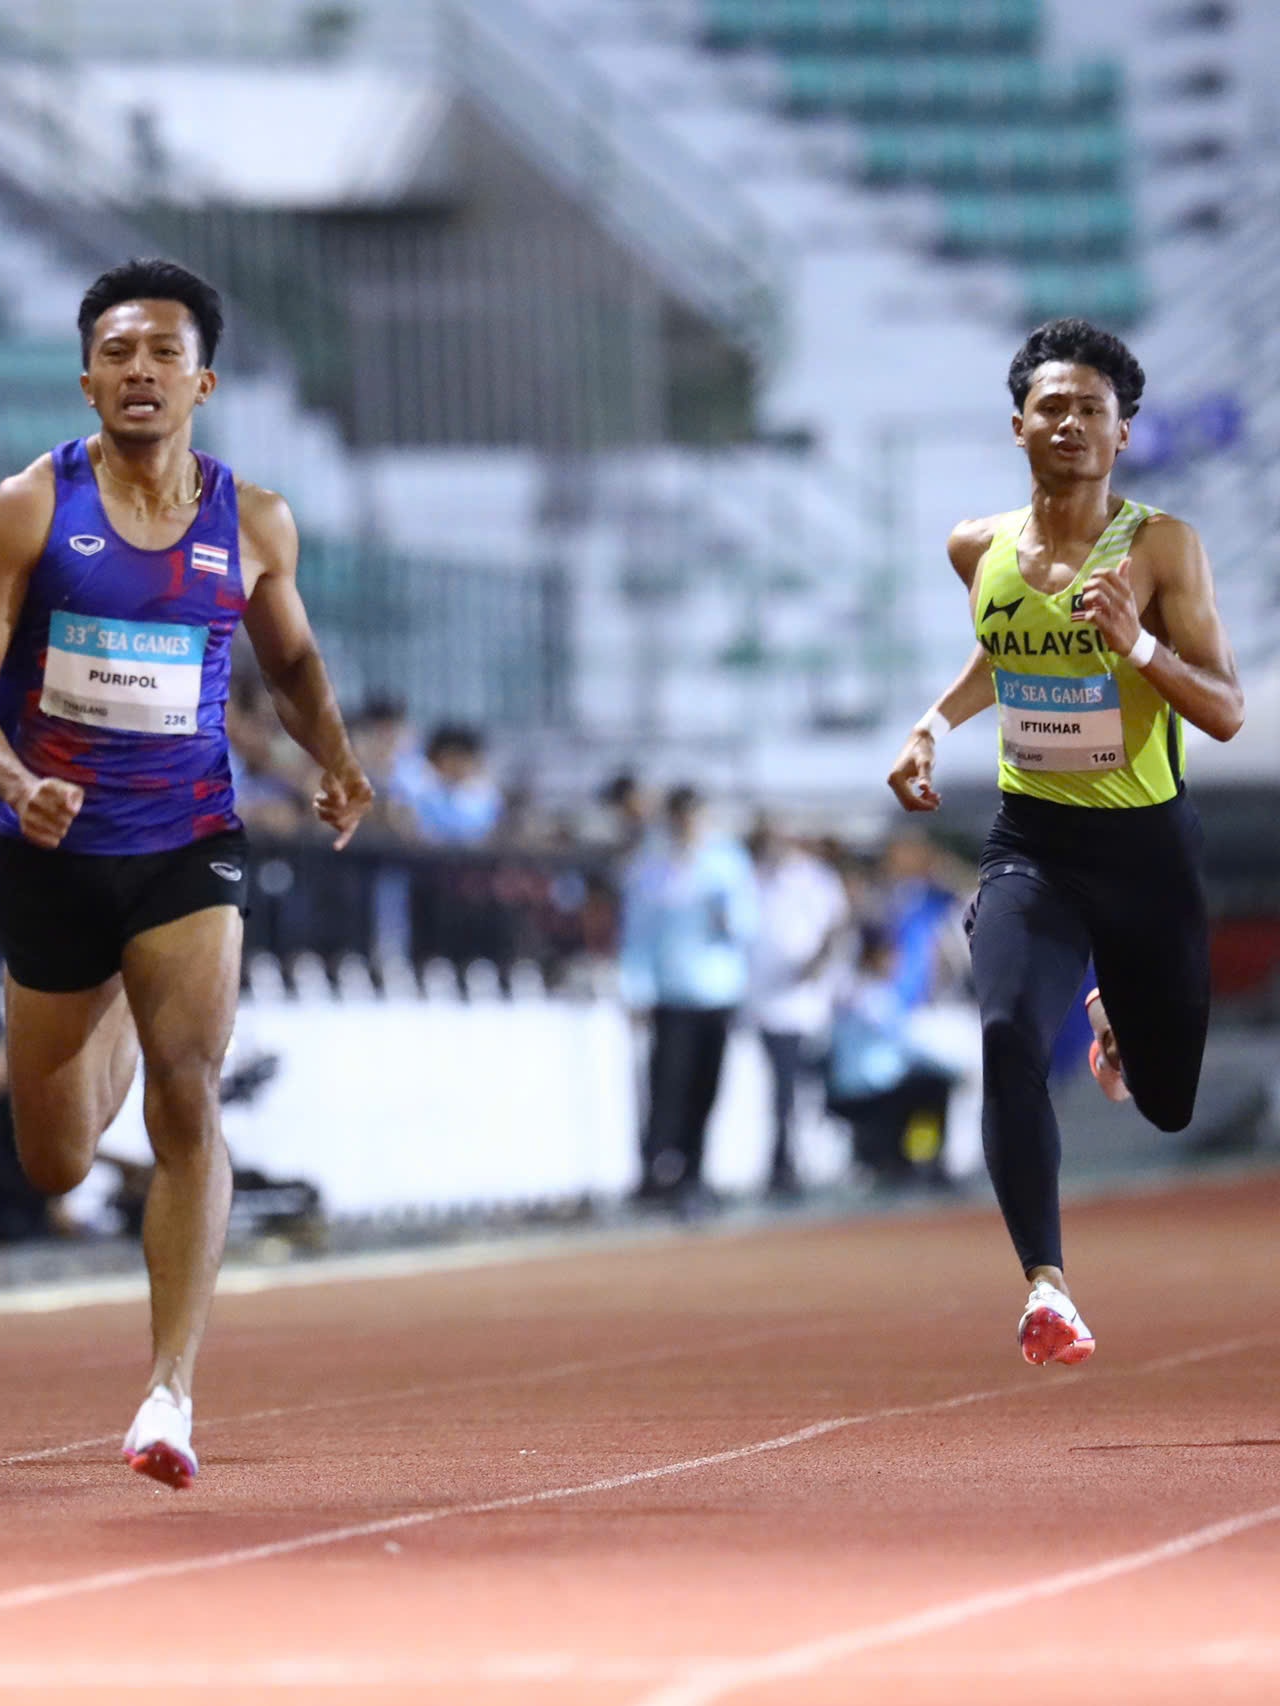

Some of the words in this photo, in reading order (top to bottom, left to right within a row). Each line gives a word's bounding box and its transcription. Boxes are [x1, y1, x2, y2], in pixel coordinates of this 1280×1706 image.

[96, 630, 128, 651] SEA
[133, 632, 192, 656] GAMES
[981, 629, 1116, 656] MALAYSI
[88, 669, 158, 689] PURIPOL
[1022, 685, 1048, 703] SEA
[1051, 687, 1103, 704] GAMES
[164, 715, 187, 726] 236
[1020, 721, 1081, 734] IFTIKHAR
[1092, 752, 1116, 763] 140
